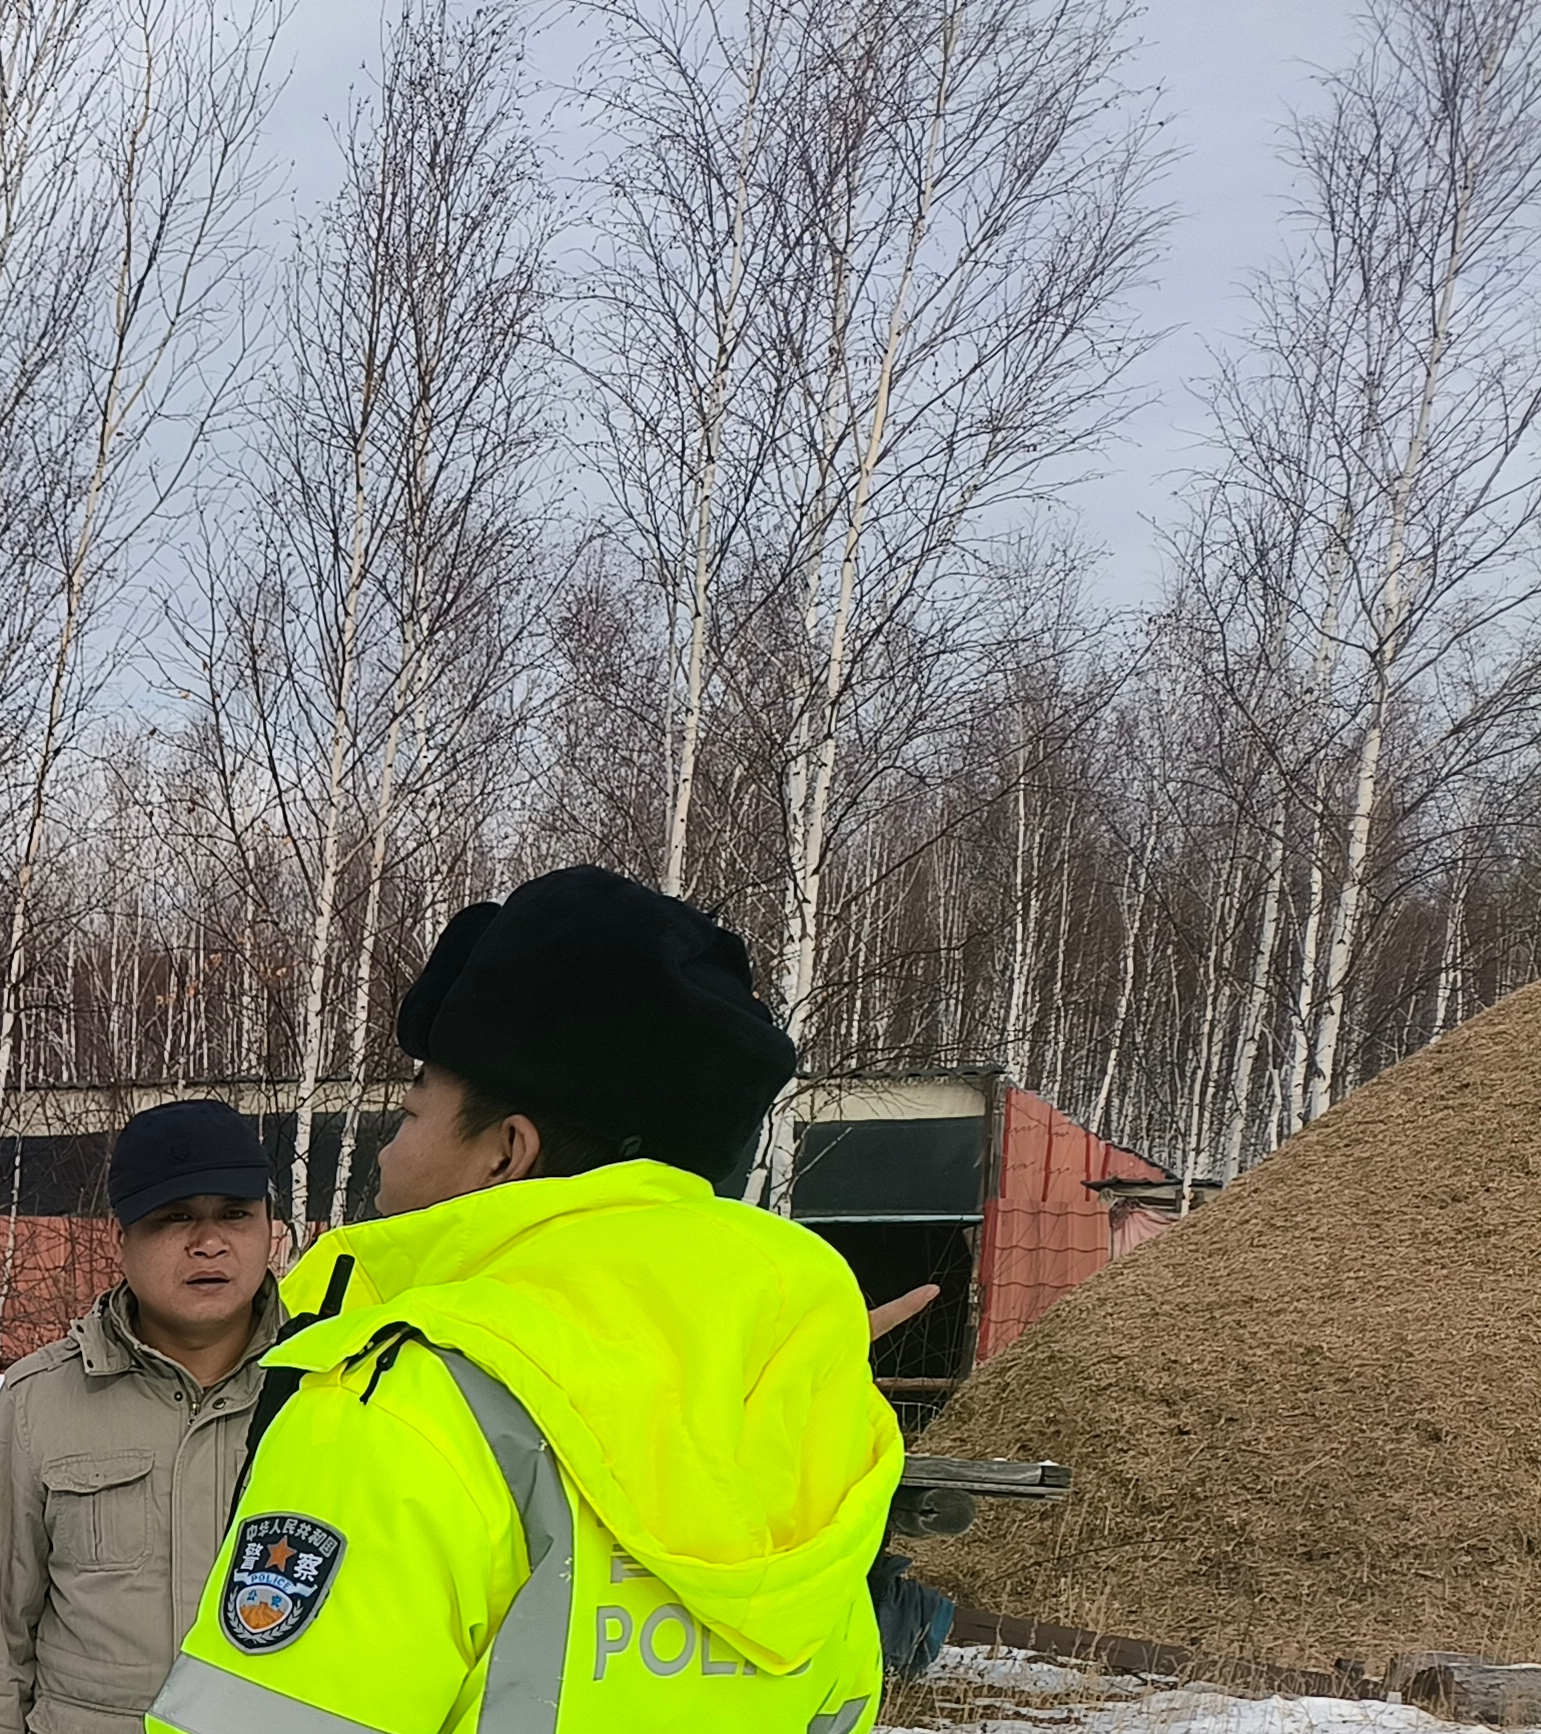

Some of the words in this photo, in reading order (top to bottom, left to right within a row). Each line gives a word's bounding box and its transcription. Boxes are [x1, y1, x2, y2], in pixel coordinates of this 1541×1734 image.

[246, 1518, 338, 1558] 中华人民共和国
[250, 1573, 292, 1592] POLICE
